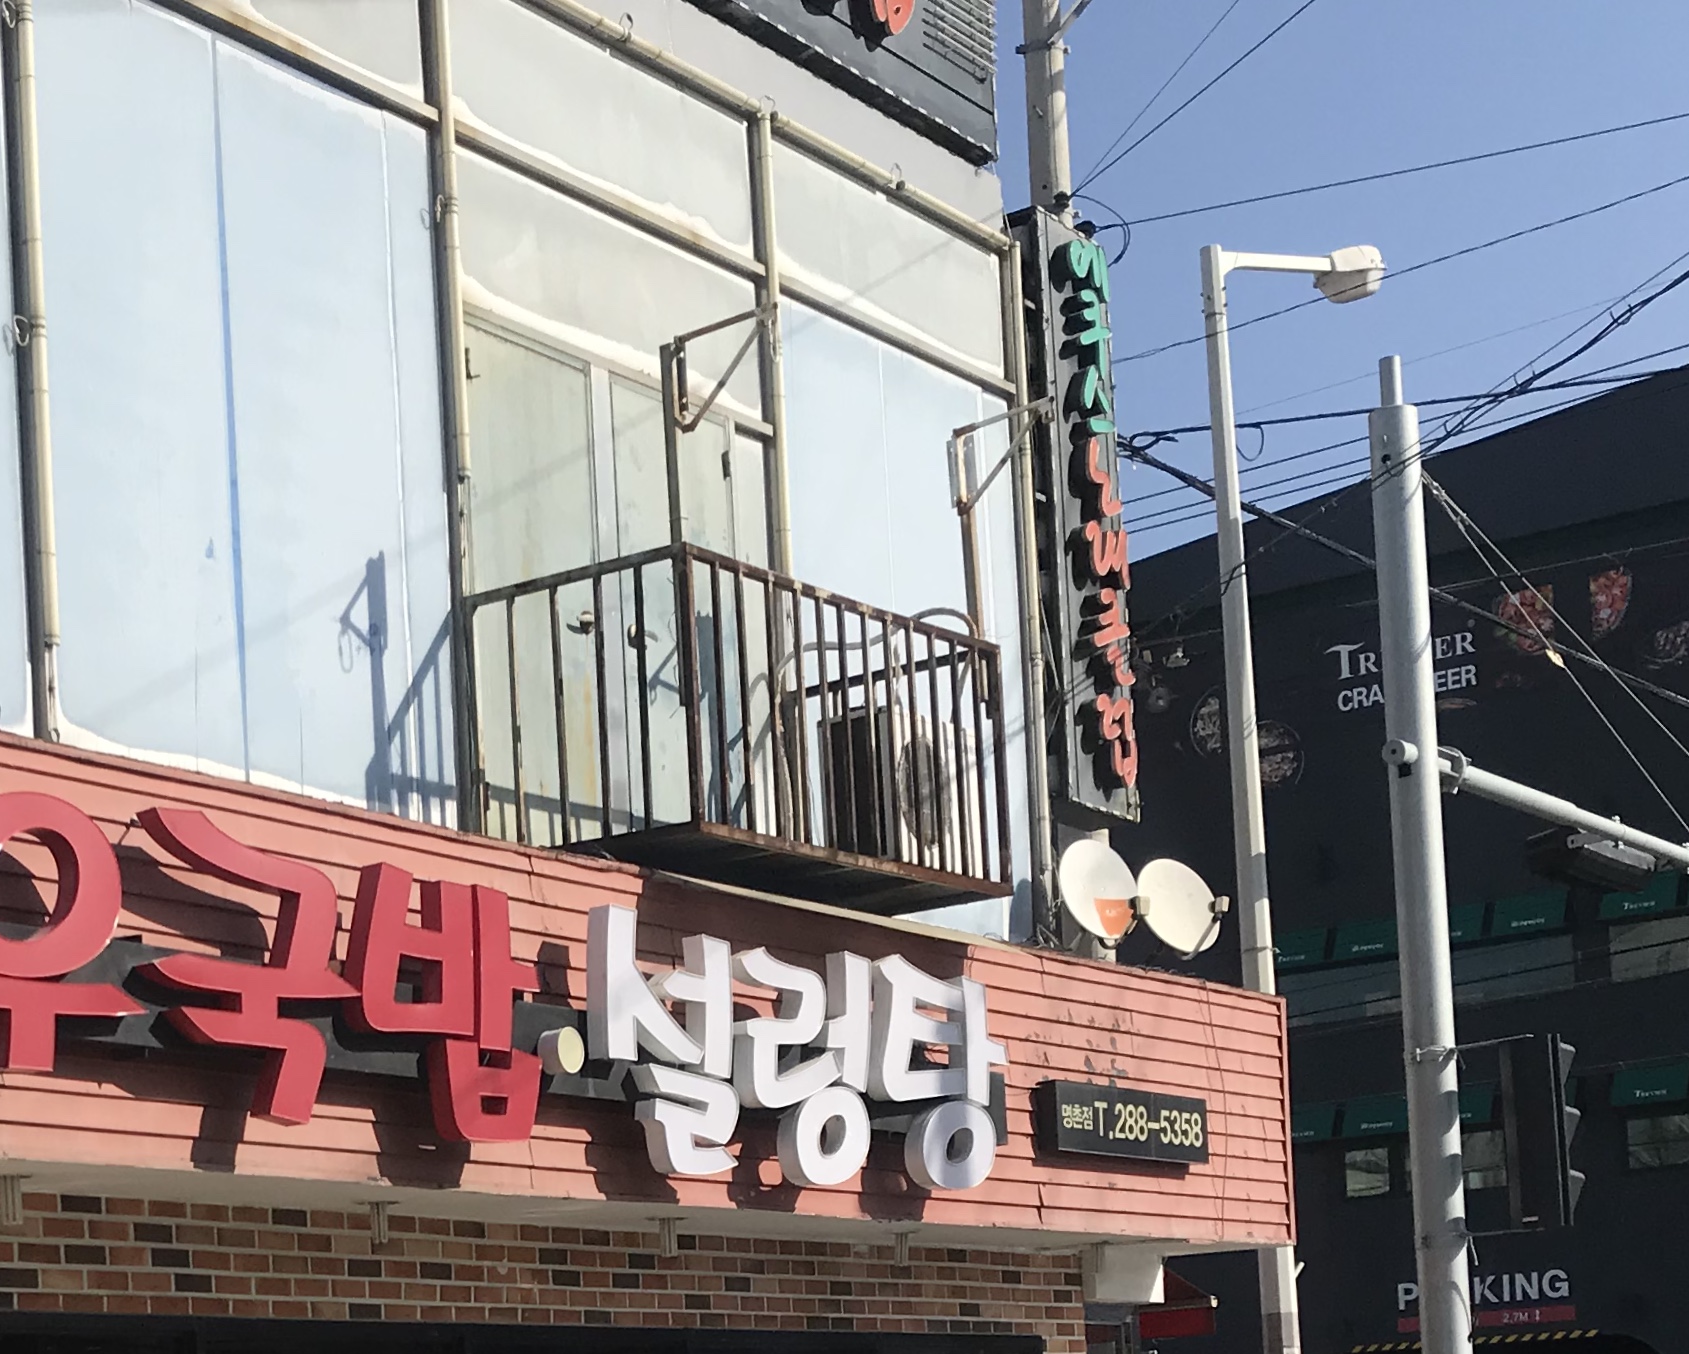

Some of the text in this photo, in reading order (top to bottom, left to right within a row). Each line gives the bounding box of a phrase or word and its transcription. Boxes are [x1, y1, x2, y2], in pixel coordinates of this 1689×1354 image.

[1324, 631, 1476, 680] TRER
[1337, 664, 1477, 711] CRA EER
[586, 903, 1010, 1190] 설렁탕
[1061, 1100, 1203, 1148] 명촌점 T.288-5358
[1397, 1269, 1571, 1311] PKING
